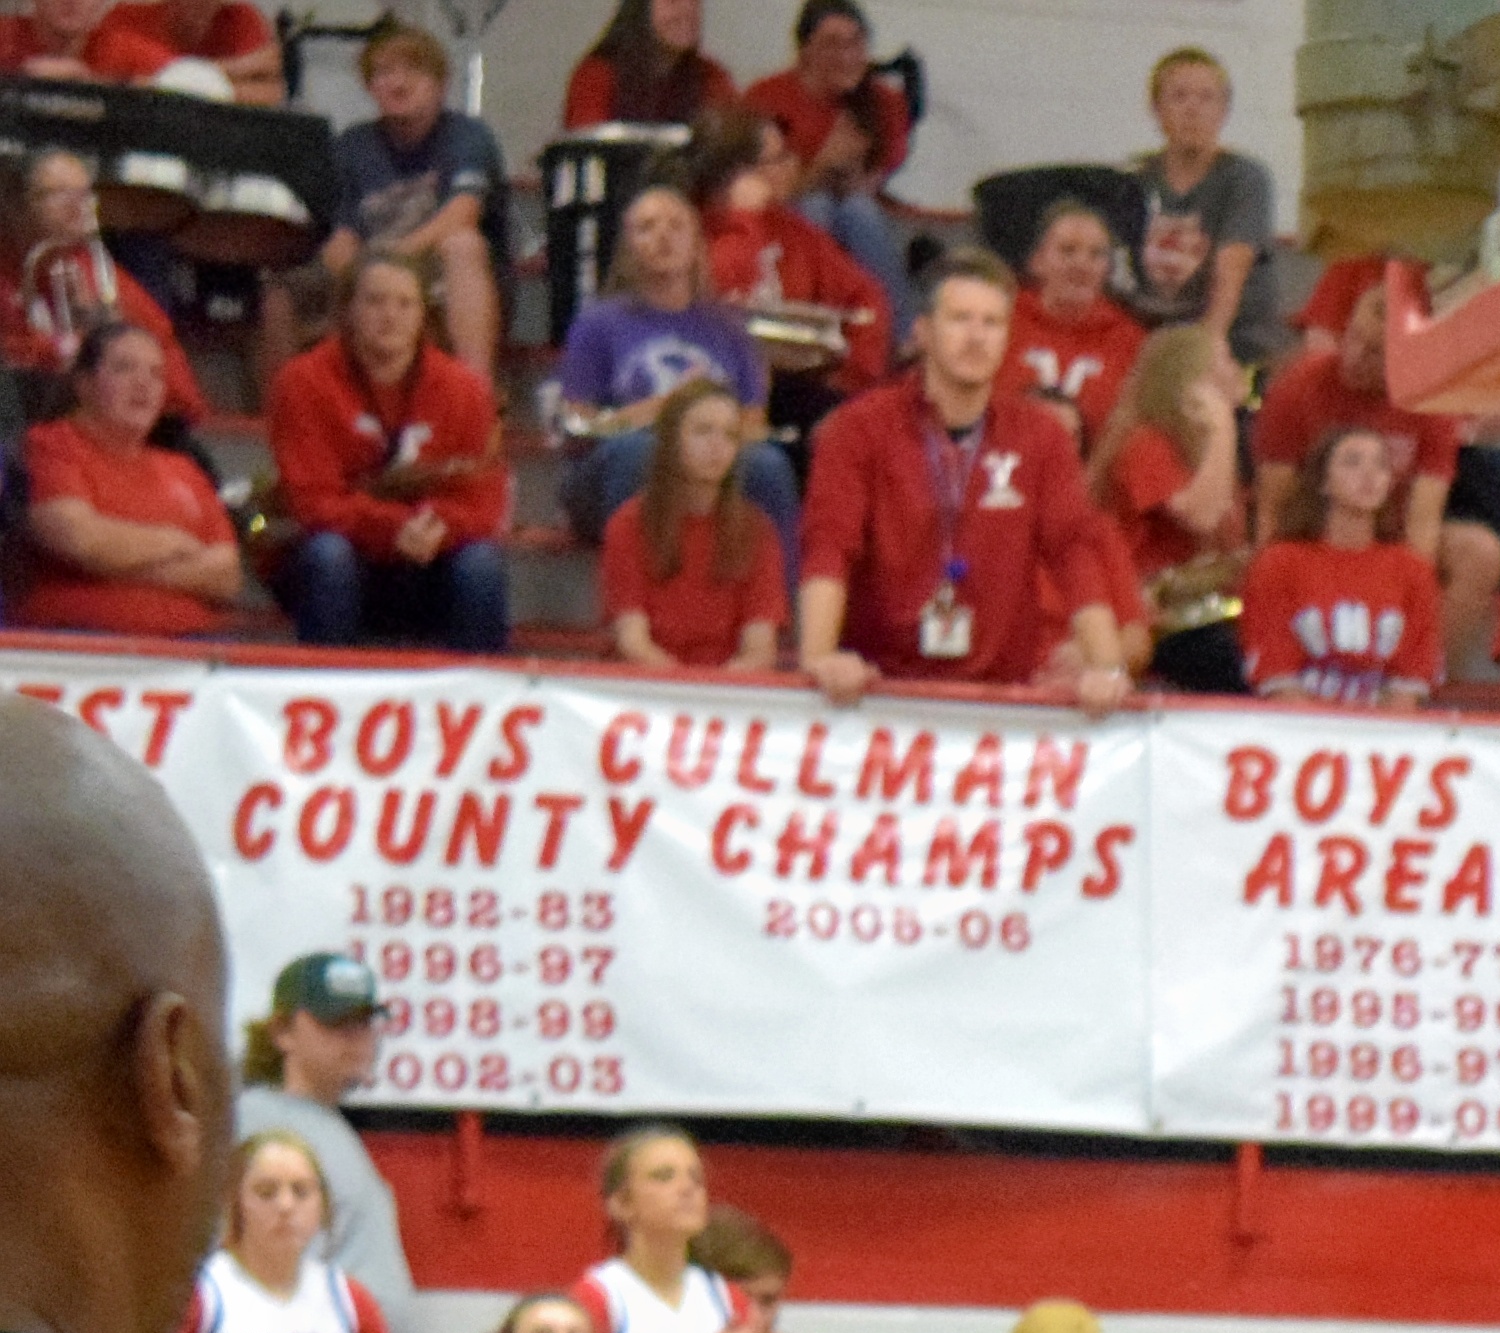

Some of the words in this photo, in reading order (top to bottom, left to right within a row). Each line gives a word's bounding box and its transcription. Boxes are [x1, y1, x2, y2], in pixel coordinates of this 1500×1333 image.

[282, 696, 543, 782] BOYS
[599, 712, 1088, 810] CULLMAN
[1224, 745, 1470, 831] BOYS
[232, 783, 653, 870] COUNTY
[710, 804, 1135, 900] CHAMPS
[1243, 834, 1495, 915] AREA
[351, 885, 615, 932] 1982-83
